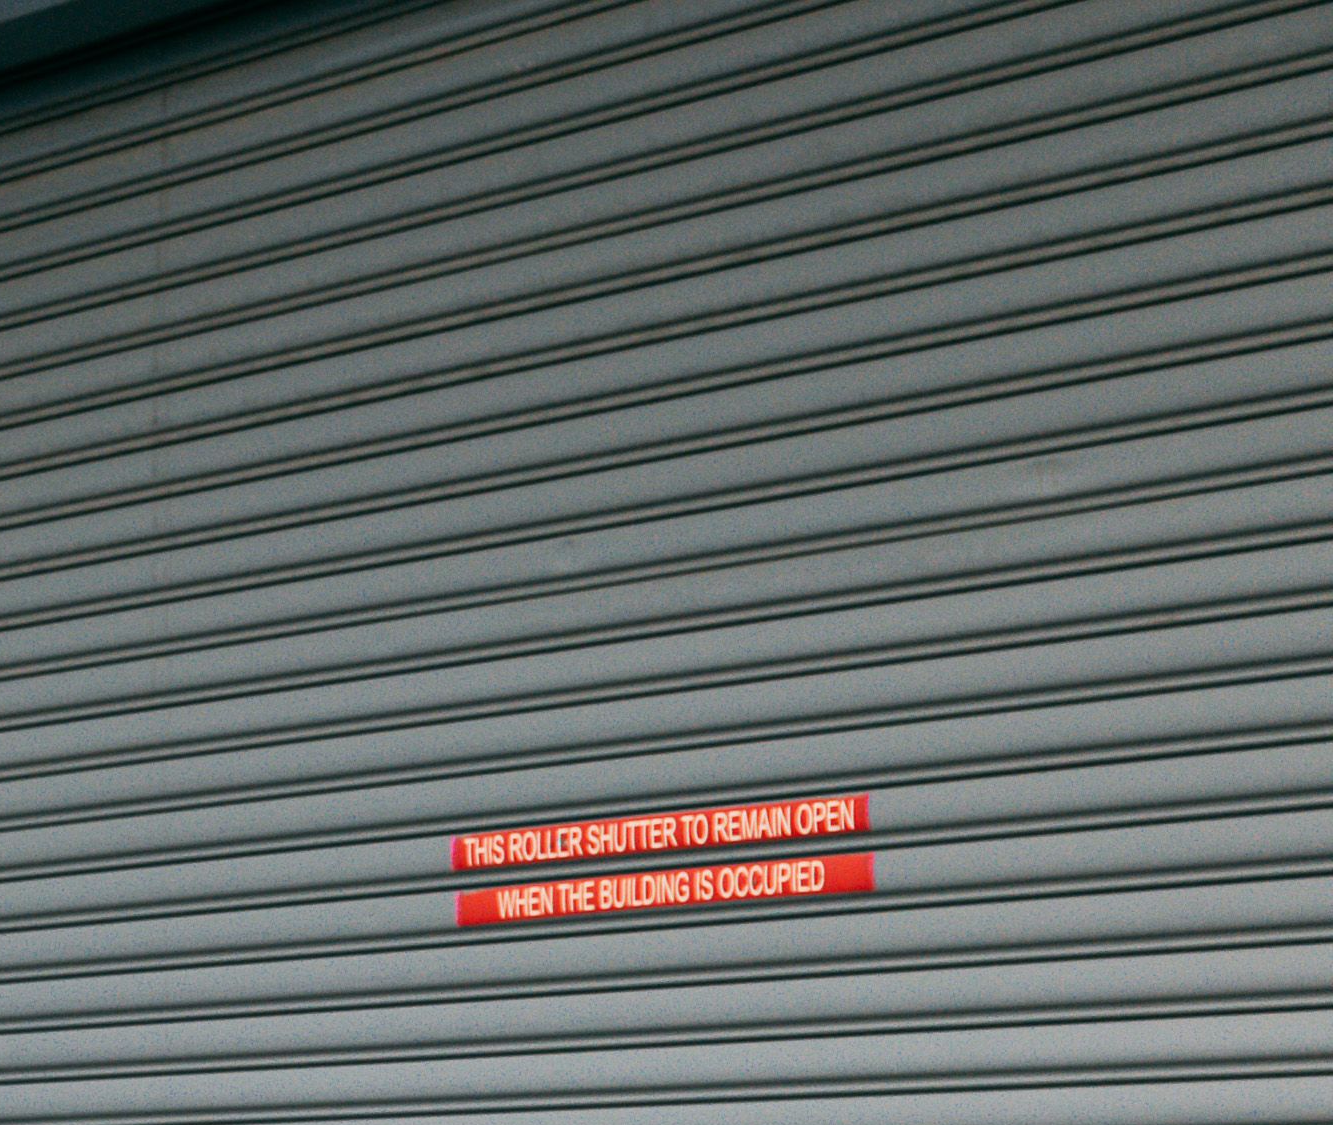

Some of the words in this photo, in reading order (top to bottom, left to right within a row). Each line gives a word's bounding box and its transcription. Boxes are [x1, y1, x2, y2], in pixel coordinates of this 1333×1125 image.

[464, 834, 506, 867] THIS
[509, 826, 584, 863] ROLLER
[587, 816, 678, 855] SHUTTER
[680, 813, 709, 846] TO
[713, 805, 792, 843] REMAIN
[796, 799, 855, 836] OPEN
[497, 885, 554, 919] WHEN
[557, 880, 596, 914] THE
[598, 871, 691, 910] BUILDING
[695, 869, 715, 901] IS
[717, 860, 826, 899] OCCUPIED
